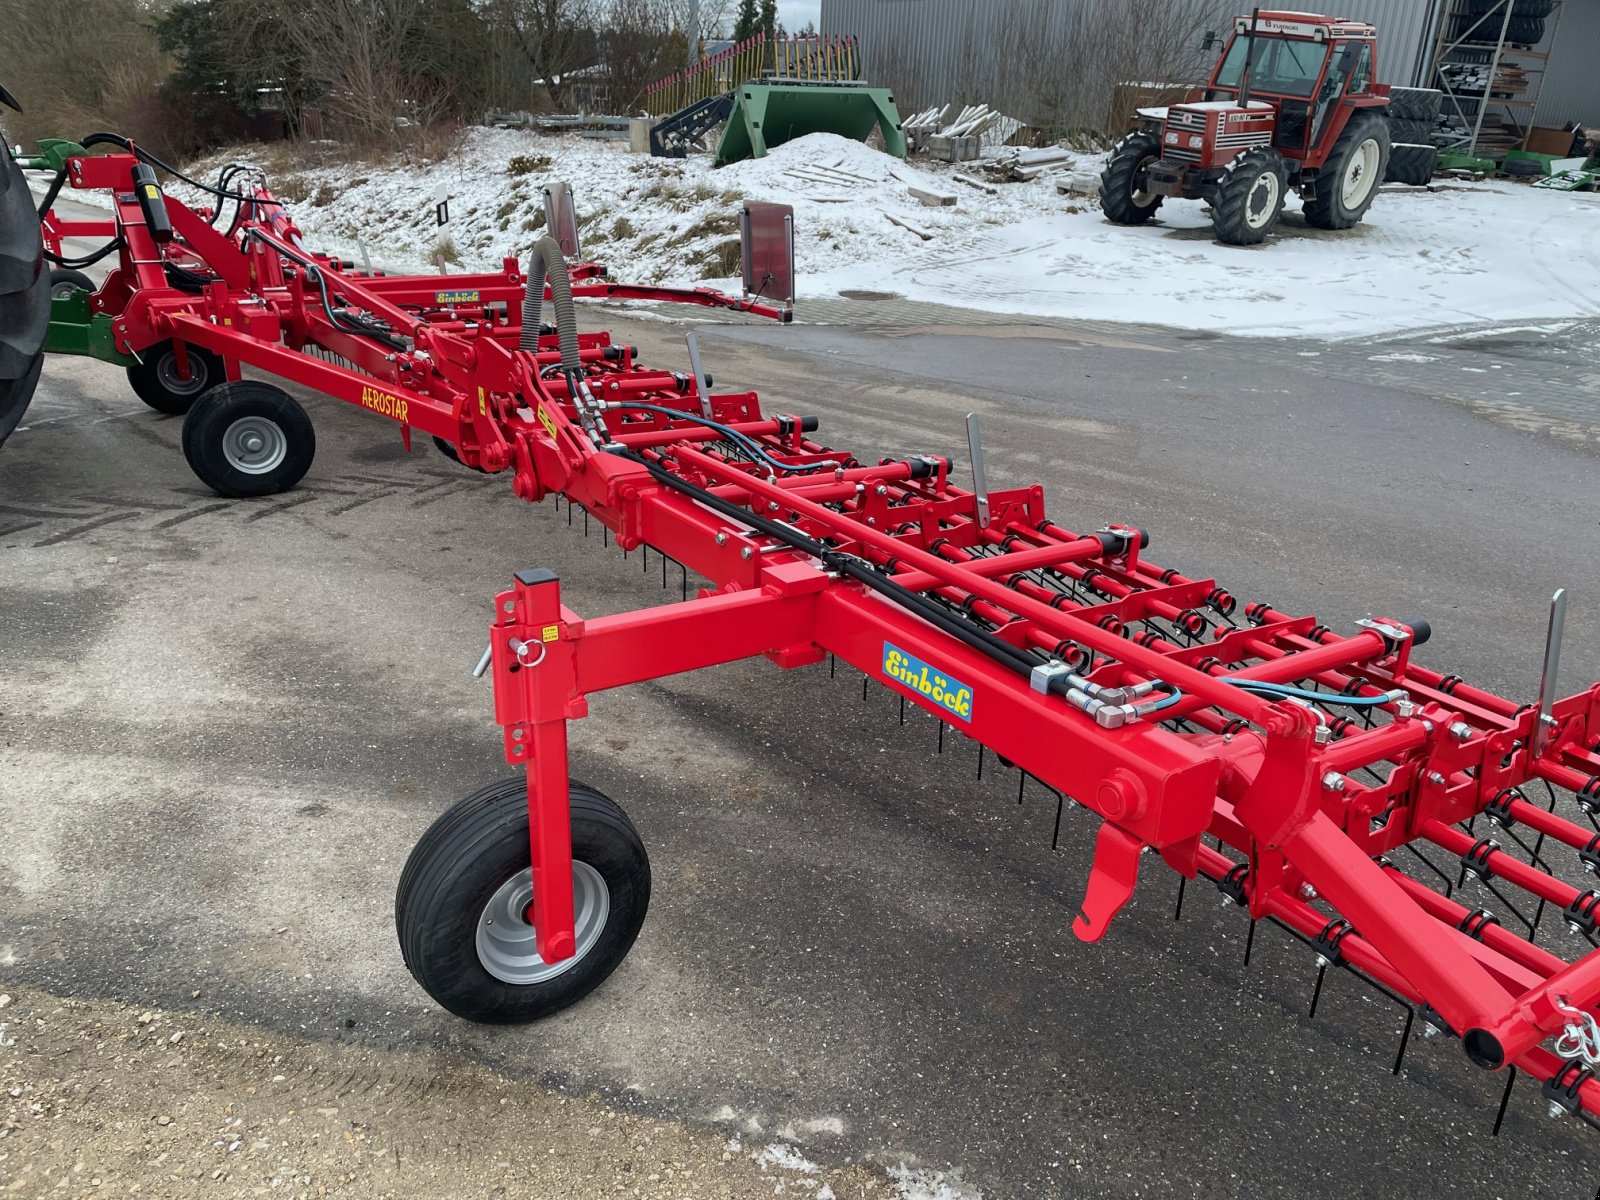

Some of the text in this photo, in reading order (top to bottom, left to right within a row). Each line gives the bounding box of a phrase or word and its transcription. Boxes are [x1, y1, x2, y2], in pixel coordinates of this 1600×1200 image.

[437, 291, 479, 303] Einböck
[362, 385, 409, 424] AEROSTAR
[885, 650, 970, 717] Einböck
